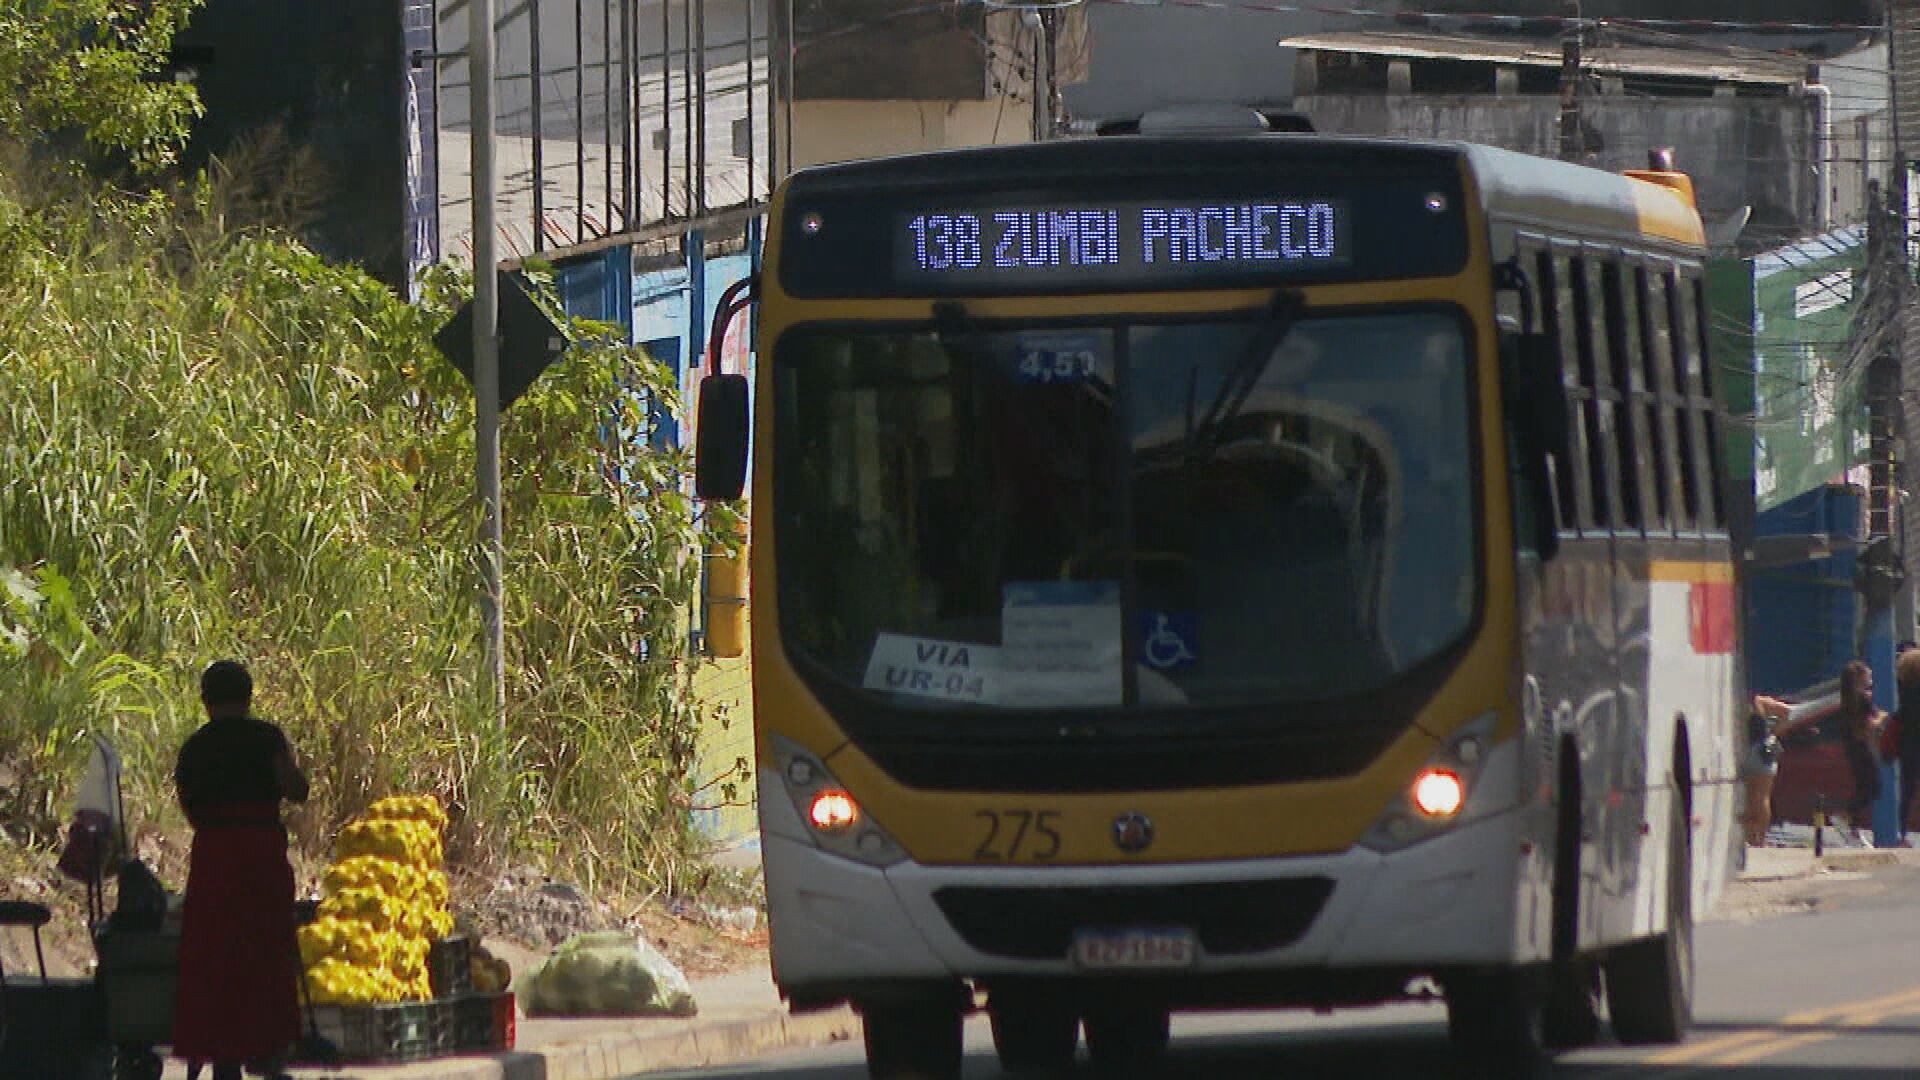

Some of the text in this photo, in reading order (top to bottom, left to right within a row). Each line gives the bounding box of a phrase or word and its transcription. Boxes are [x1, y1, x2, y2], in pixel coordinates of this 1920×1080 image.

[907, 203, 1335, 269] 138 ZUMBI PACHECO
[916, 642, 970, 668] VIA
[974, 810, 1062, 860] 275
